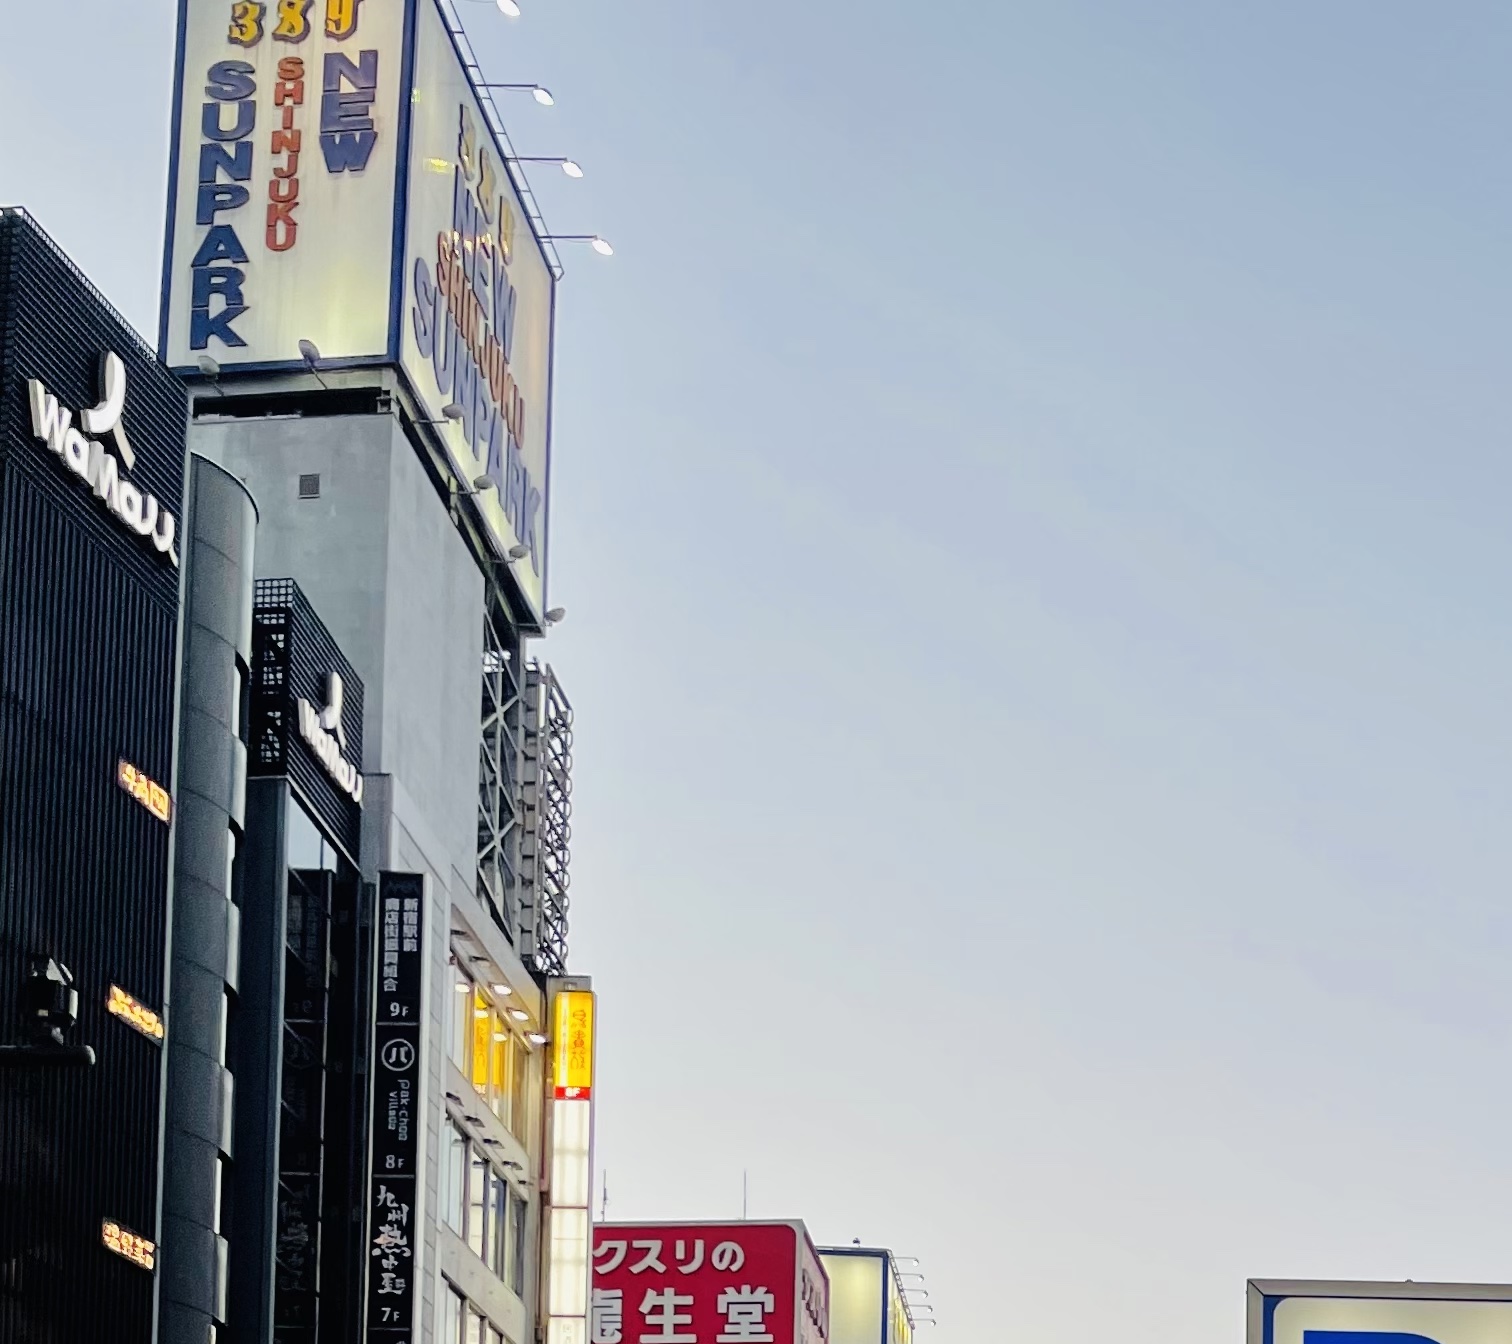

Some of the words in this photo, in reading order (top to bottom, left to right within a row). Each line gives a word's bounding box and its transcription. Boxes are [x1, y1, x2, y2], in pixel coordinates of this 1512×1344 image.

[319, 50, 378, 173] NEW
[265, 56, 305, 252] SHINJUKU
[190, 60, 256, 350] SUNPARK
[389, 1002, 409, 1017] 9F
[386, 1155, 404, 1169] 8F
[593, 1240, 746, 1274] クスリの
[381, 1308, 400, 1321] 7F
